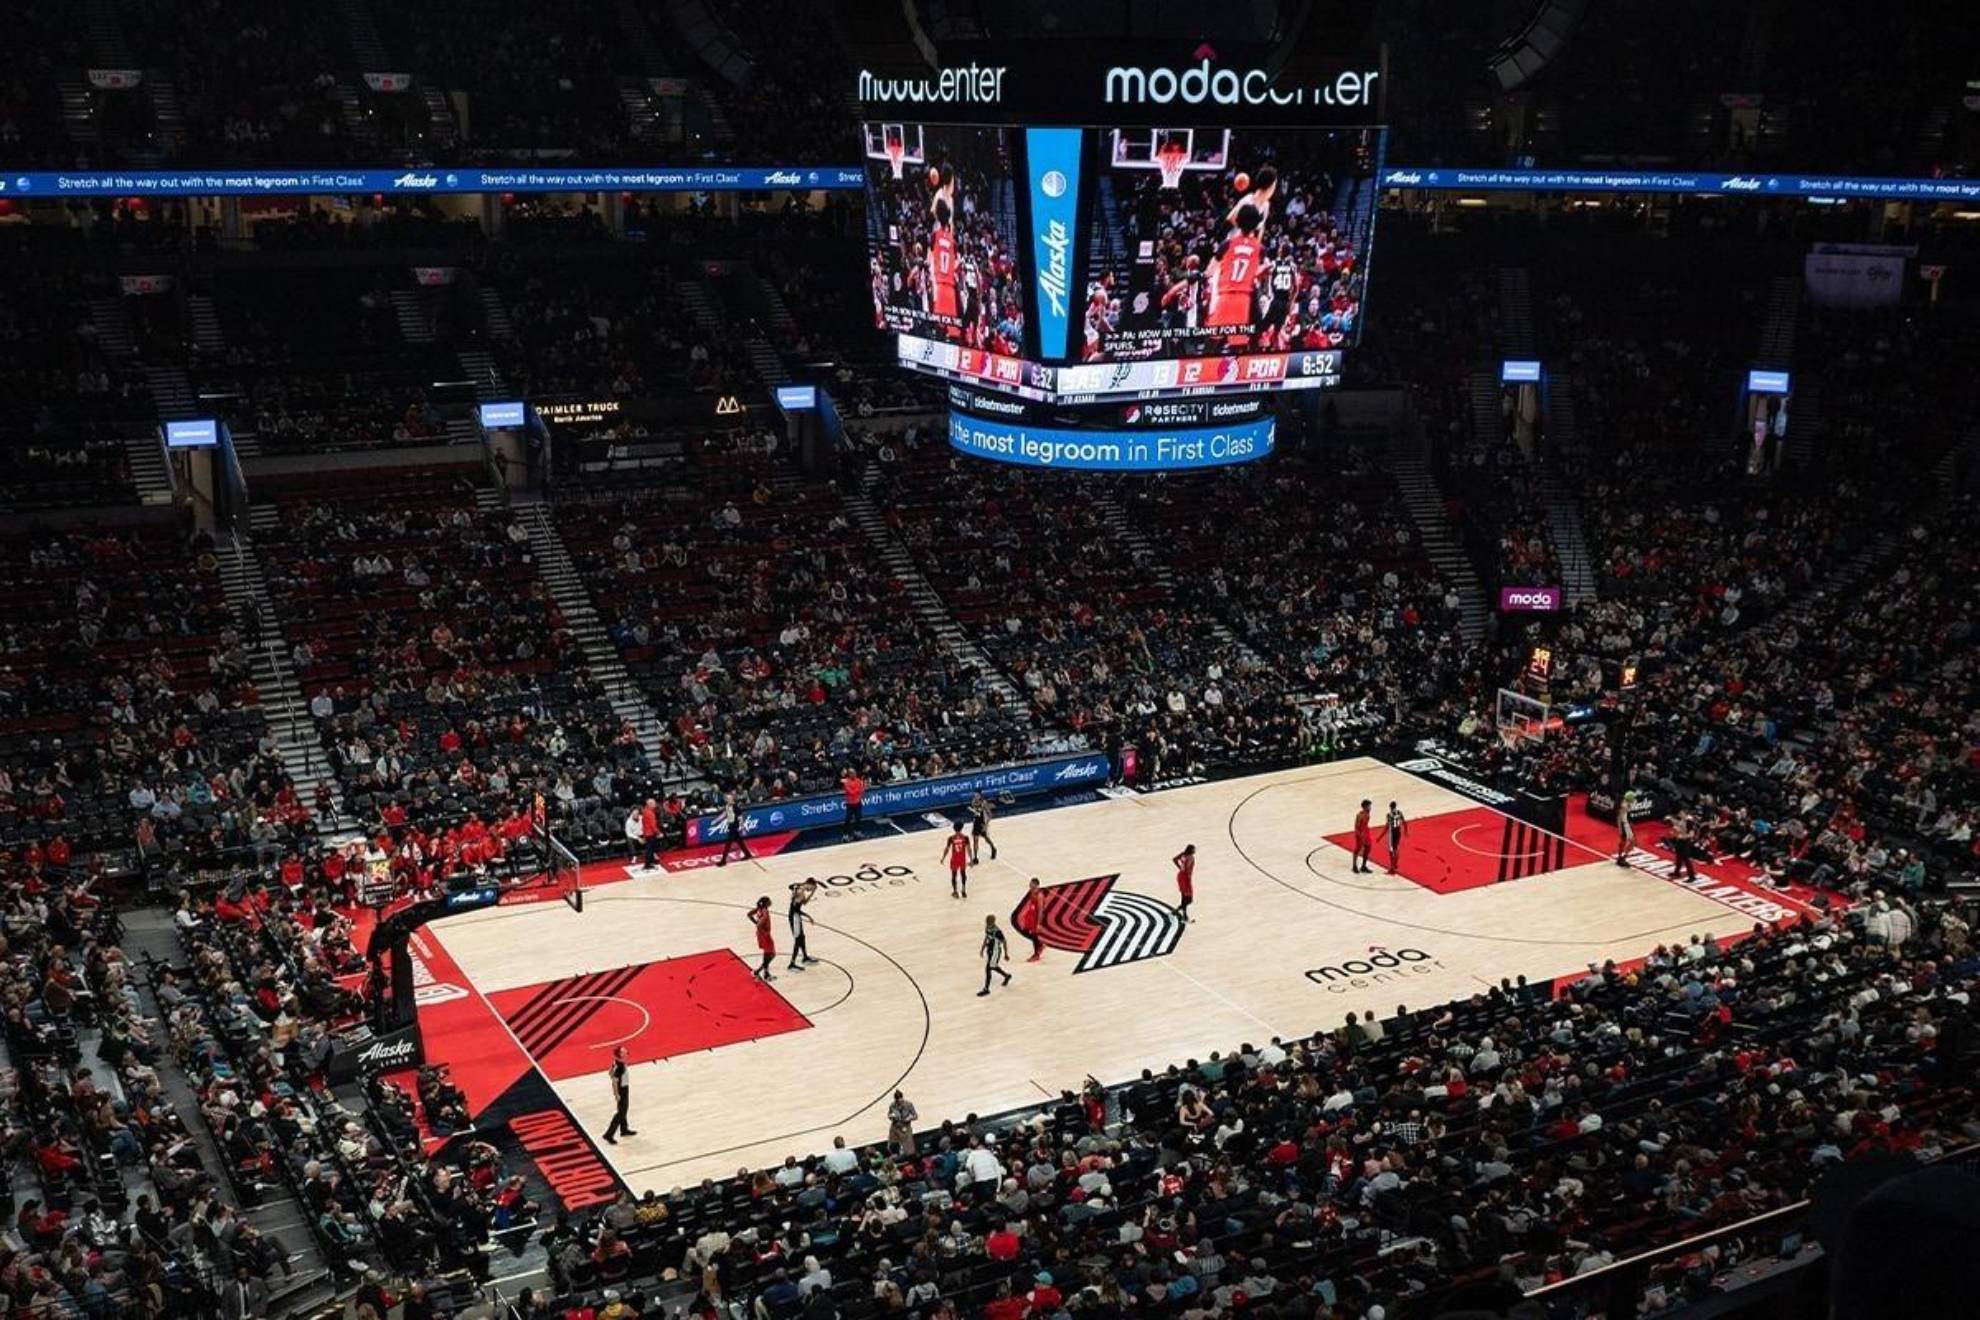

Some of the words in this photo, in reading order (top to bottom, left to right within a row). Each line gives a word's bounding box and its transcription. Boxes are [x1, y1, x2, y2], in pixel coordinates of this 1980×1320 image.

[58, 177, 99, 188] Stretch
[101, 177, 113, 188] all
[115, 177, 133, 188] the
[135, 178, 157, 189] way
[160, 178, 178, 188] out
[180, 177, 203, 187] with
[206, 177, 223, 187] the
[225, 177, 251, 187] most
[255, 176, 298, 188] legroom
[300, 176, 309, 186] in
[312, 175, 334, 186] First
[394, 173, 438, 188] Alaska
[481, 174, 514, 185] Stretch
[517, 174, 527, 185] all
[529, 174, 544, 185] the
[546, 175, 565, 186] way
[567, 175, 582, 185] out
[584, 174, 604, 185] with
[606, 174, 620, 184] the
[622, 174, 644, 184] most
[646, 174, 684, 186] legroom
[686, 174, 693, 183] in
[695, 173, 714, 183] First
[764, 171, 800, 185] Alaska
[1458, 173, 1487, 183] Stretch
[1488, 173, 1497, 183] all
[1499, 173, 1512, 183] the
[1514, 175, 1530, 185] way
[1532, 174, 1546, 184] out
[1548, 174, 1565, 184] with
[1567, 175, 1580, 184] the
[1582, 175, 1603, 185] most
[1605, 176, 1640, 187] legroom
[1642, 176, 1650, 185] in
[1652, 176, 1671, 186] First
[1721, 177, 1761, 190] Alaska
[1800, 180, 1831, 190] Stretch
[1833, 180, 1844, 190] all
[1845, 181, 1859, 190] the
[1861, 183, 1879, 192] way
[1881, 183, 1896, 192] out
[1898, 183, 1918, 193] with
[1920, 184, 1933, 193] the
[1936, 184, 1960, 194] most
[1039, 219, 1070, 318] Alaska
[1230, 258, 1250, 282] 17
[1274, 273, 1291, 290] 40
[1138, 329, 1160, 339] NOW
[1162, 329, 1172, 338] IN
[1174, 327, 1191, 337] THE
[1192, 325, 1217, 336] GAME
[1219, 325, 1236, 335] FOR
[1239, 324, 1255, 334] THE
[1246, 358, 1281, 379] POR
[1302, 354, 1333, 376] 6:52
[535, 403, 583, 415] DAIMLER
[587, 402, 620, 413] TRUCK
[955, 418, 970, 444] the
[973, 431, 1015, 455] most
[1020, 433, 1120, 464] legroom
[1128, 438, 1148, 462] in
[1158, 438, 1204, 462] First
[1509, 592, 1552, 605] moda
[1055, 762, 1099, 780] Alaska
[861, 791, 883, 808] with
[885, 787, 901, 803] the
[904, 785, 929, 799] most
[932, 776, 973, 797] legroom
[976, 778, 983, 788] in
[985, 773, 1006, 786] First
[801, 801, 838, 817] Stretch
[814, 875, 920, 900] enter
[1304, 949, 1432, 984] moda
[1327, 960, 1446, 994] center
[357, 1038, 415, 1063] Alaska
[508, 1109, 618, 1213] PORTLAND
